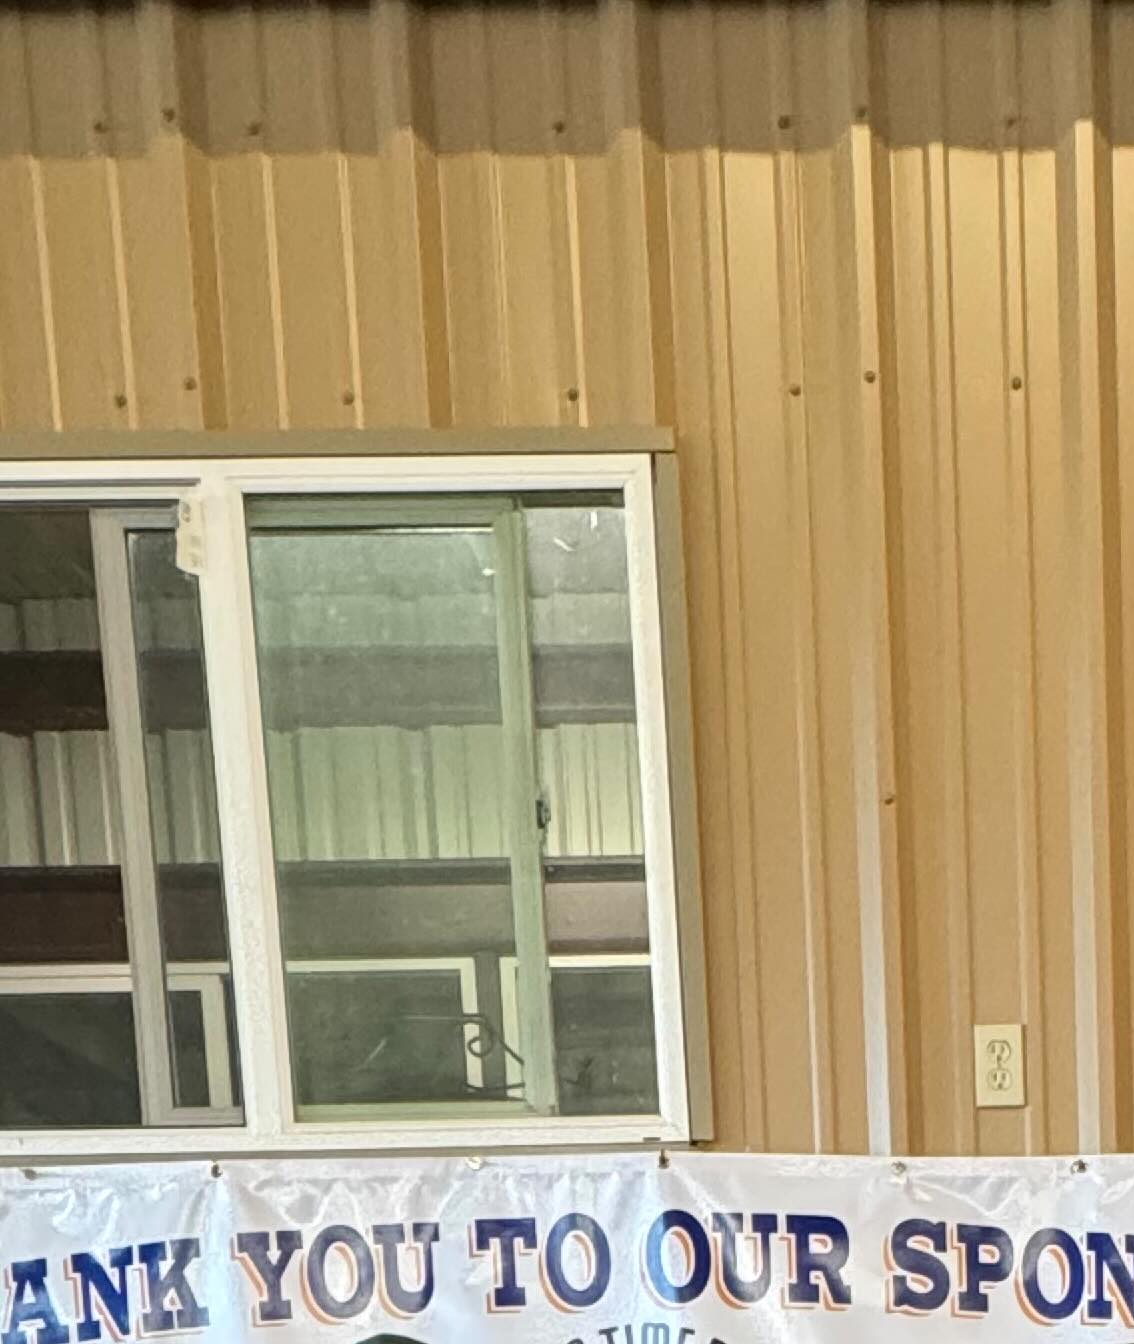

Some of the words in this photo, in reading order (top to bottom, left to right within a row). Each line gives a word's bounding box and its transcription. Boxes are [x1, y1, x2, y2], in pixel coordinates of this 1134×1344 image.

[231, 1222, 441, 1327] YOU
[469, 1212, 611, 1313] TO
[640, 1209, 852, 1311] OUR
